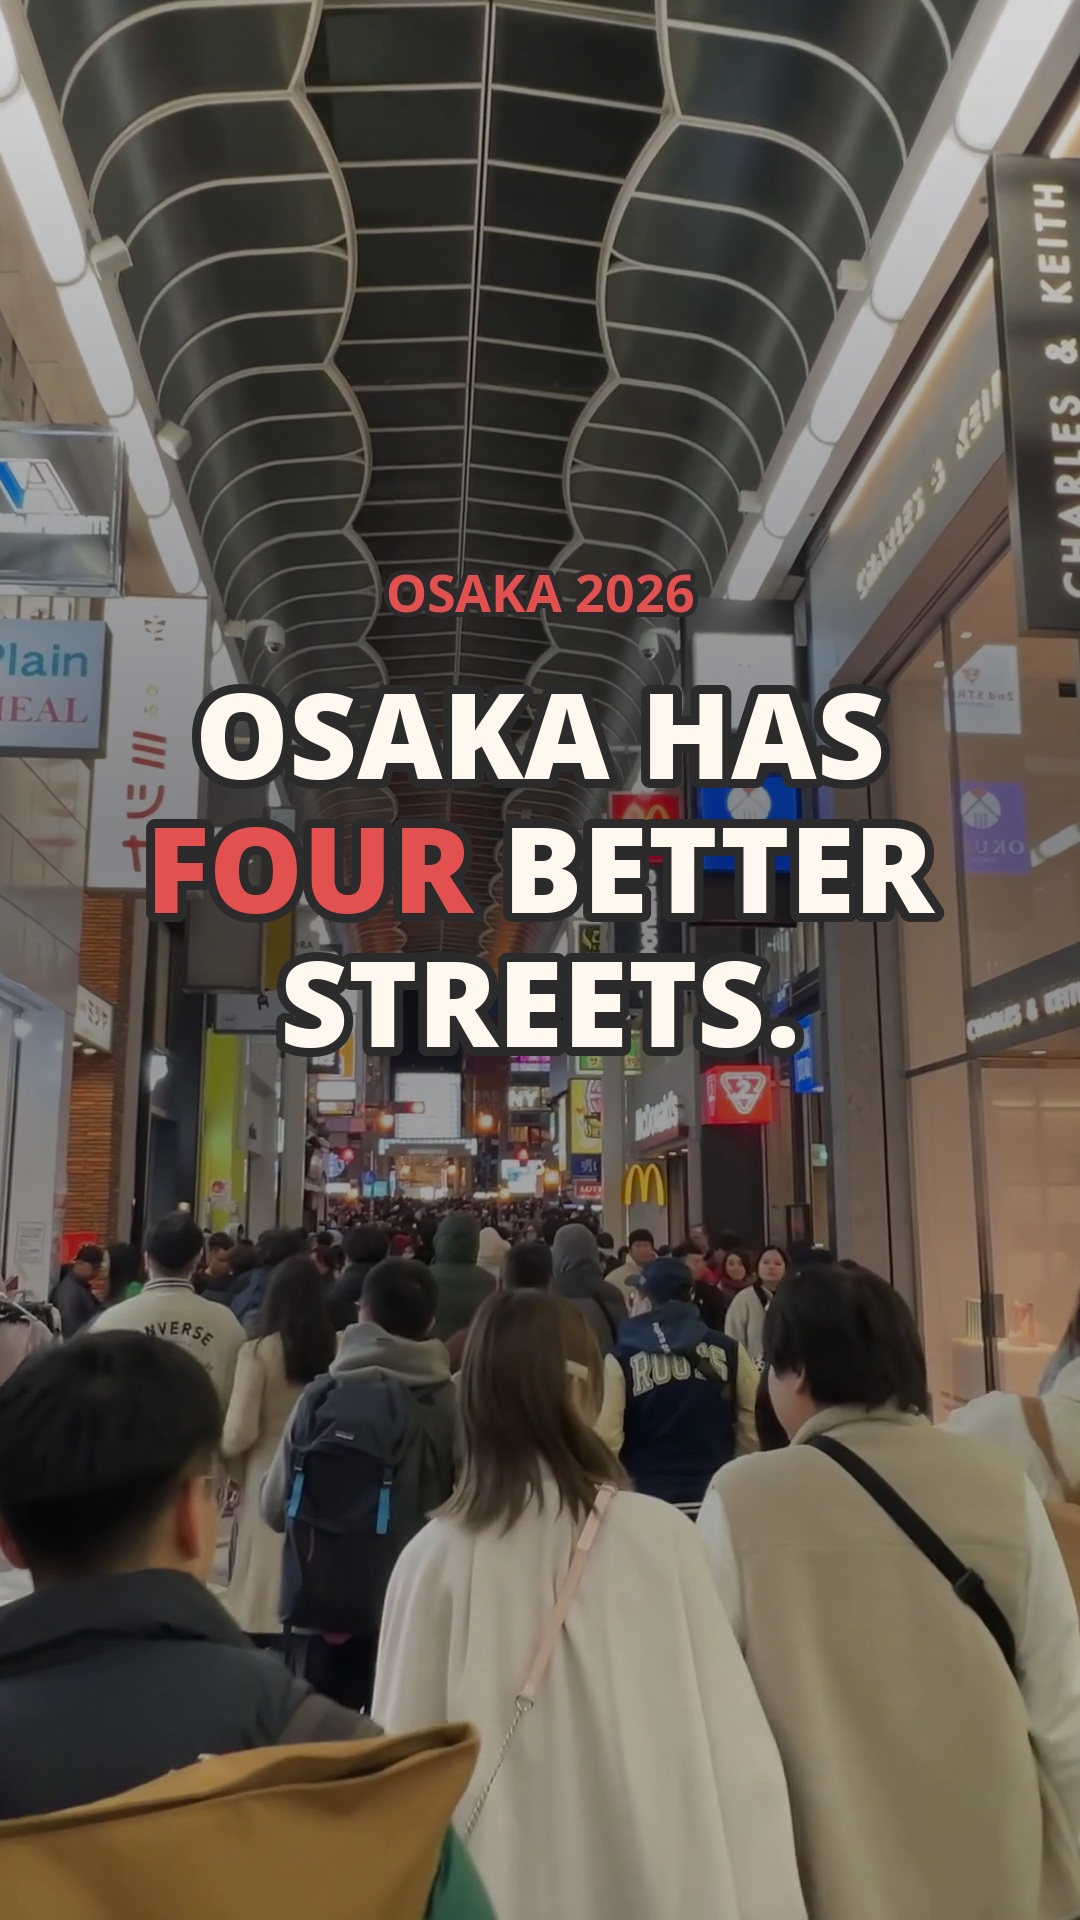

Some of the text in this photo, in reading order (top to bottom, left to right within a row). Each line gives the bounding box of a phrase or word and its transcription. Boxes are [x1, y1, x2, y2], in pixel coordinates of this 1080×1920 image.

[1033, 184, 1073, 303] KEITH
[1045, 338, 1078, 364] &
[0, 642, 88, 677] lain
[0, 696, 88, 724] EAL
[145, 1321, 214, 1346] NVERSE
